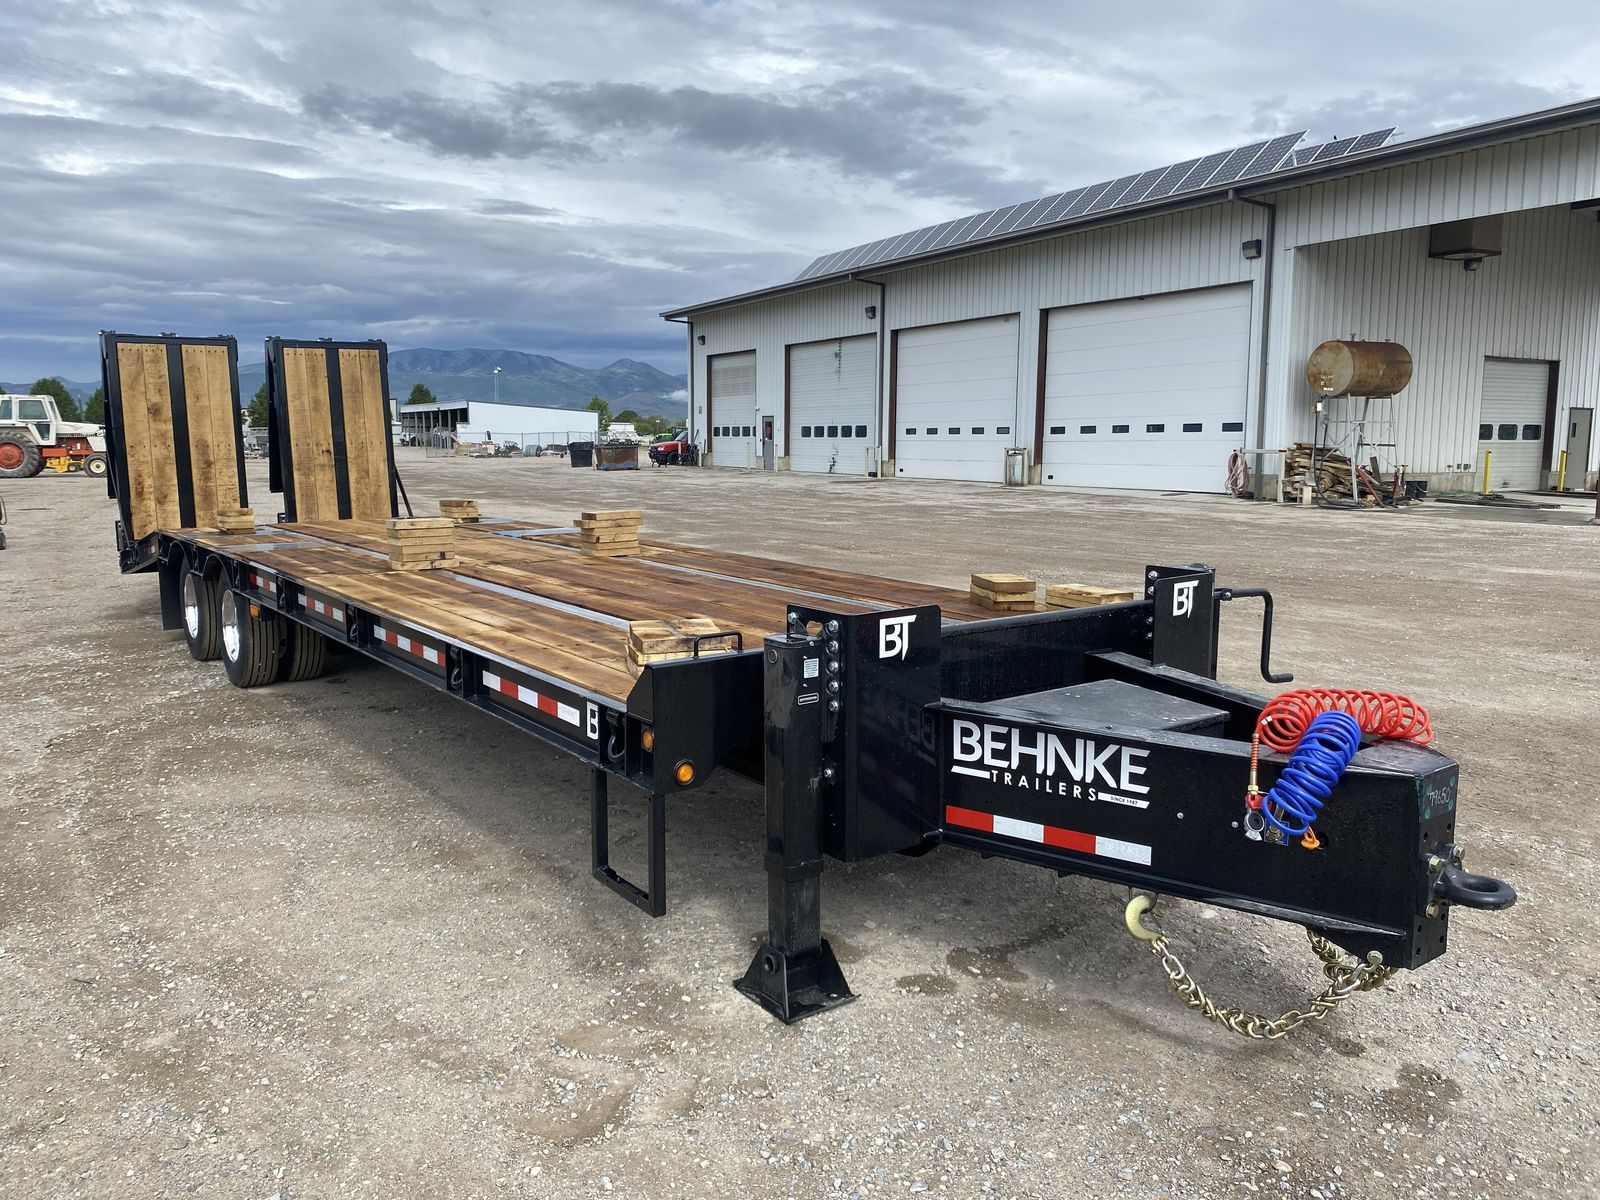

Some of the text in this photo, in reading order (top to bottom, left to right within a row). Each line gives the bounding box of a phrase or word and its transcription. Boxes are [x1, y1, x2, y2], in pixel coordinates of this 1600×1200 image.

[1172, 580, 1199, 619] BT
[879, 614, 917, 661] BT
[953, 719, 1150, 795] BEHNKE
[991, 770, 1097, 801] TRAILERS
